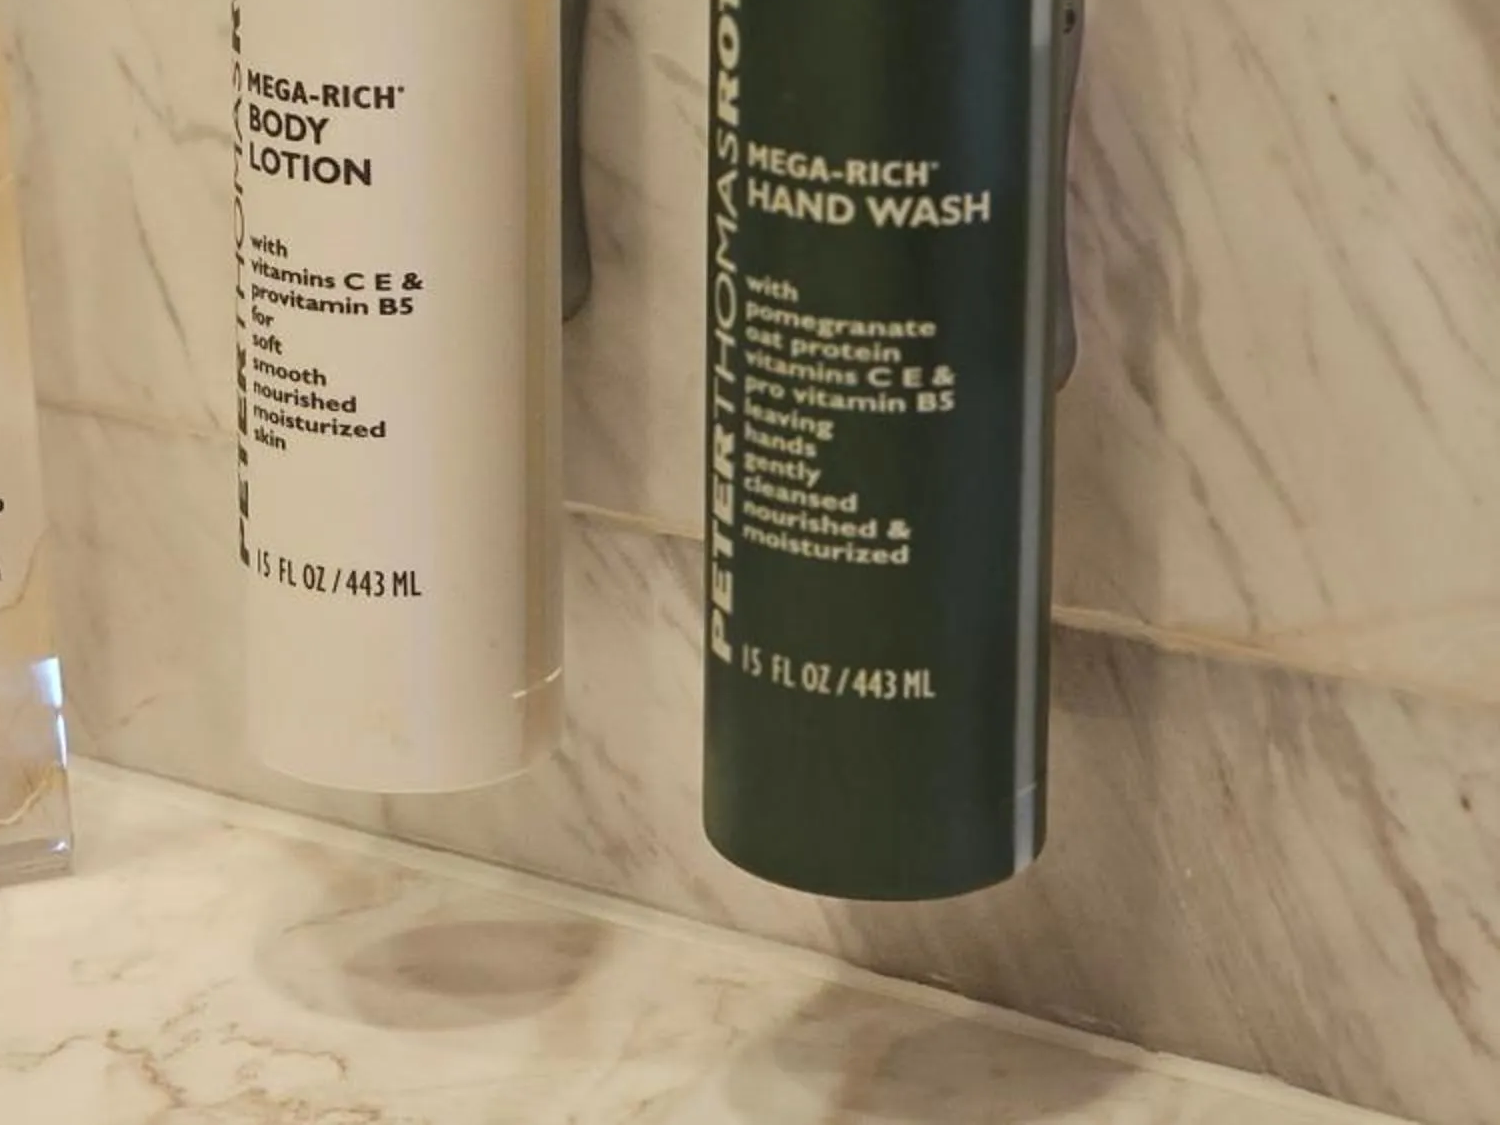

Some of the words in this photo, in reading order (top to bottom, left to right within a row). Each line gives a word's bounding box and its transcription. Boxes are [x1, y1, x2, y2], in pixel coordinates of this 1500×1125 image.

[249, 102, 330, 145] BODY
[249, 142, 372, 186] LOTION
[747, 177, 855, 225] HAND
[866, 190, 991, 228] WASH
[251, 234, 288, 259] with
[251, 257, 336, 290] vitamins
[344, 273, 365, 290] C
[375, 273, 392, 291] E
[401, 273, 424, 291] &
[745, 275, 798, 303] with
[251, 282, 369, 316] provitamin
[378, 297, 414, 316] B5
[252, 306, 275, 328] for
[745, 300, 937, 339] pomegranate
[252, 333, 283, 355] soft
[745, 326, 783, 349] oat
[790, 336, 902, 363] protein
[253, 357, 328, 386] smooth
[744, 349, 859, 386] vitamins
[867, 366, 893, 388] C
[902, 367, 923, 388] E
[931, 365, 956, 387] &
[253, 381, 357, 413] nourished
[744, 375, 785, 399] pro
[793, 383, 906, 413] vitamin
[916, 391, 956, 413] B5
[253, 403, 386, 438] moisturized
[743, 398, 835, 441] leaving
[254, 427, 287, 451] skin
[743, 423, 817, 457] hands
[743, 452, 821, 488] gently
[743, 476, 858, 513] cleansed
[743, 501, 877, 539] nourished
[887, 519, 911, 539] &
[742, 525, 909, 565] moisturized
[257, 548, 270, 577] 15
[279, 557, 296, 587] FL
[303, 563, 326, 593] OZ
[346, 570, 385, 598] 443
[393, 570, 422, 597] ML
[742, 644, 762, 677] 15
[772, 653, 795, 689] FL
[802, 661, 831, 695] OZ
[852, 668, 898, 700] 443
[904, 669, 936, 699] ML
